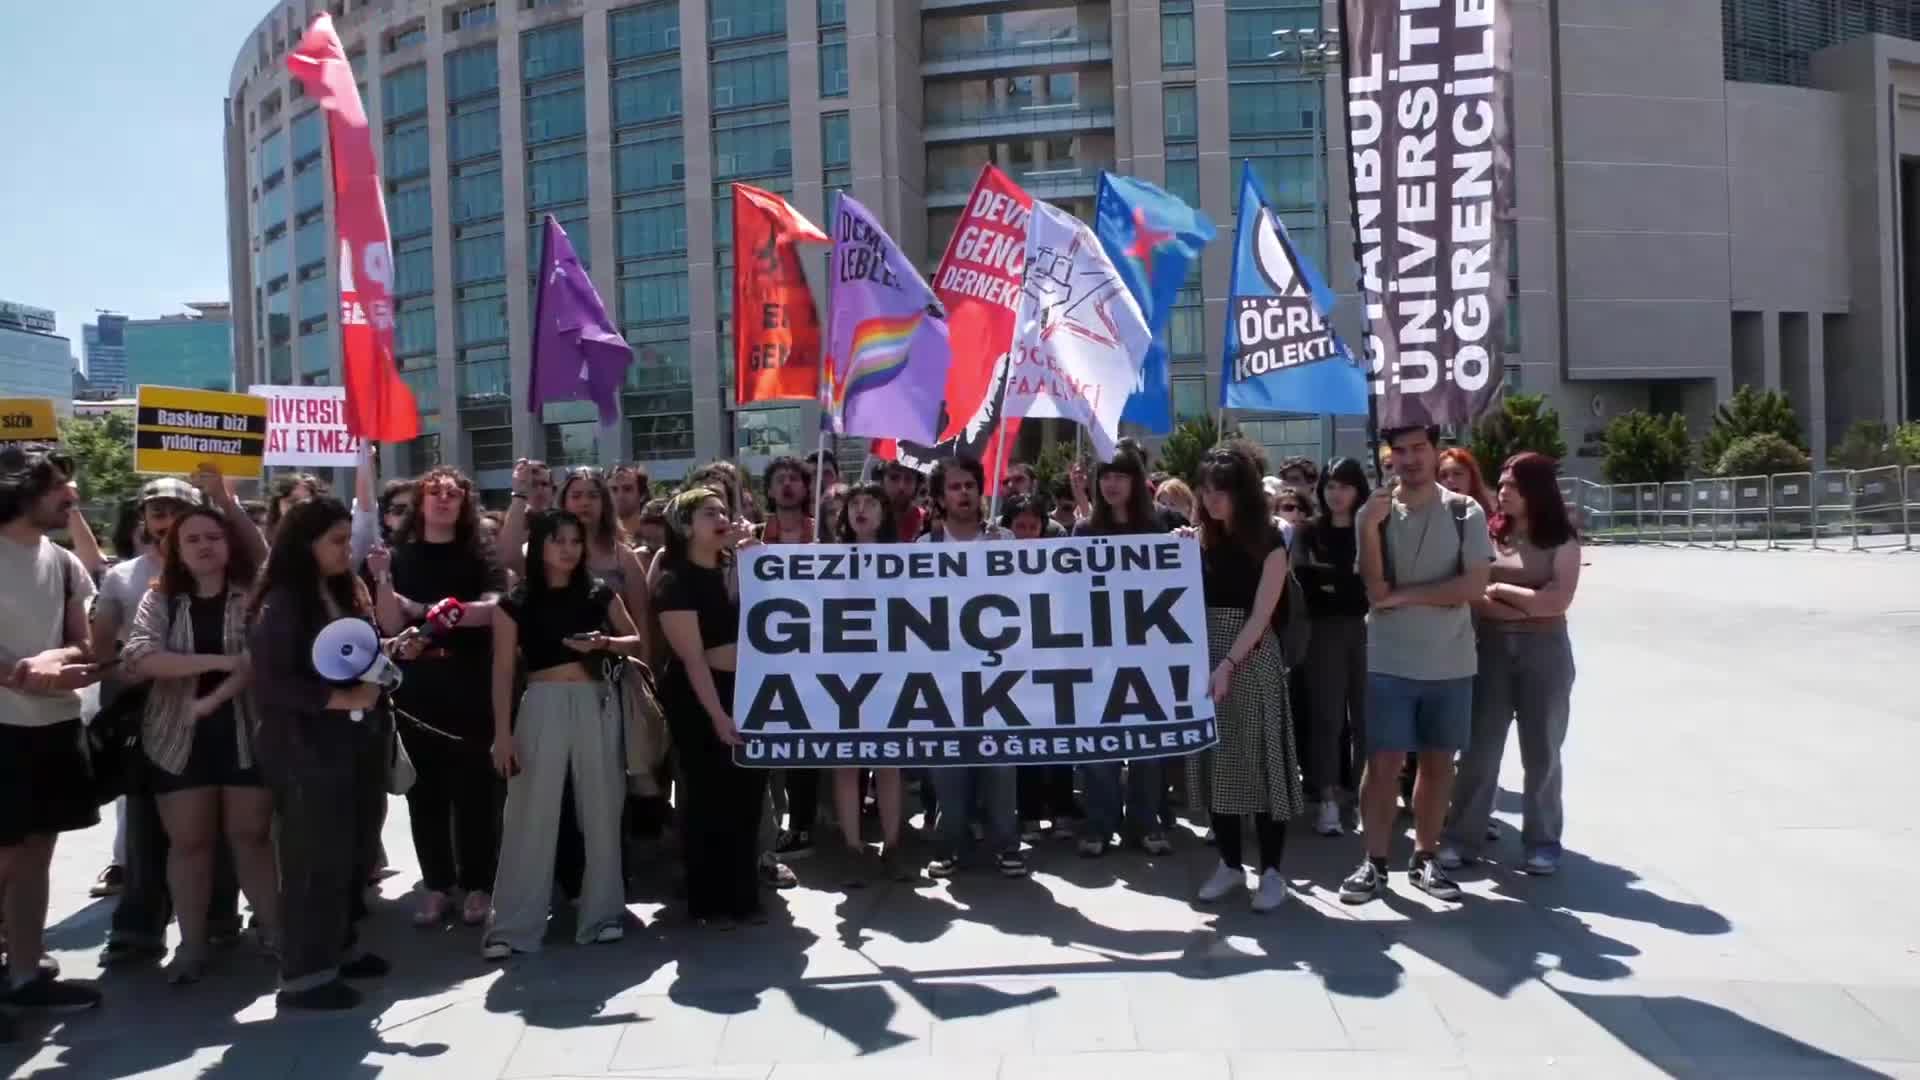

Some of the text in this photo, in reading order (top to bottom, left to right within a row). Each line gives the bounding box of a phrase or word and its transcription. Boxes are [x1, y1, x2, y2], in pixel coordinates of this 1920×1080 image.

[1388, 0, 1441, 394] ÜNİVERSİT
[840, 246, 903, 291] LEBLE
[157, 409, 249, 432] Baskılar bizi
[161, 434, 242, 455] yıldıramaz!
[752, 538, 1183, 582] GEZİ'DEN BUGÜNE
[746, 575, 1194, 668] GENÇLİK
[741, 664, 1195, 731] AYAKTA!
[745, 738, 961, 760] ÜNİVERSİTE
